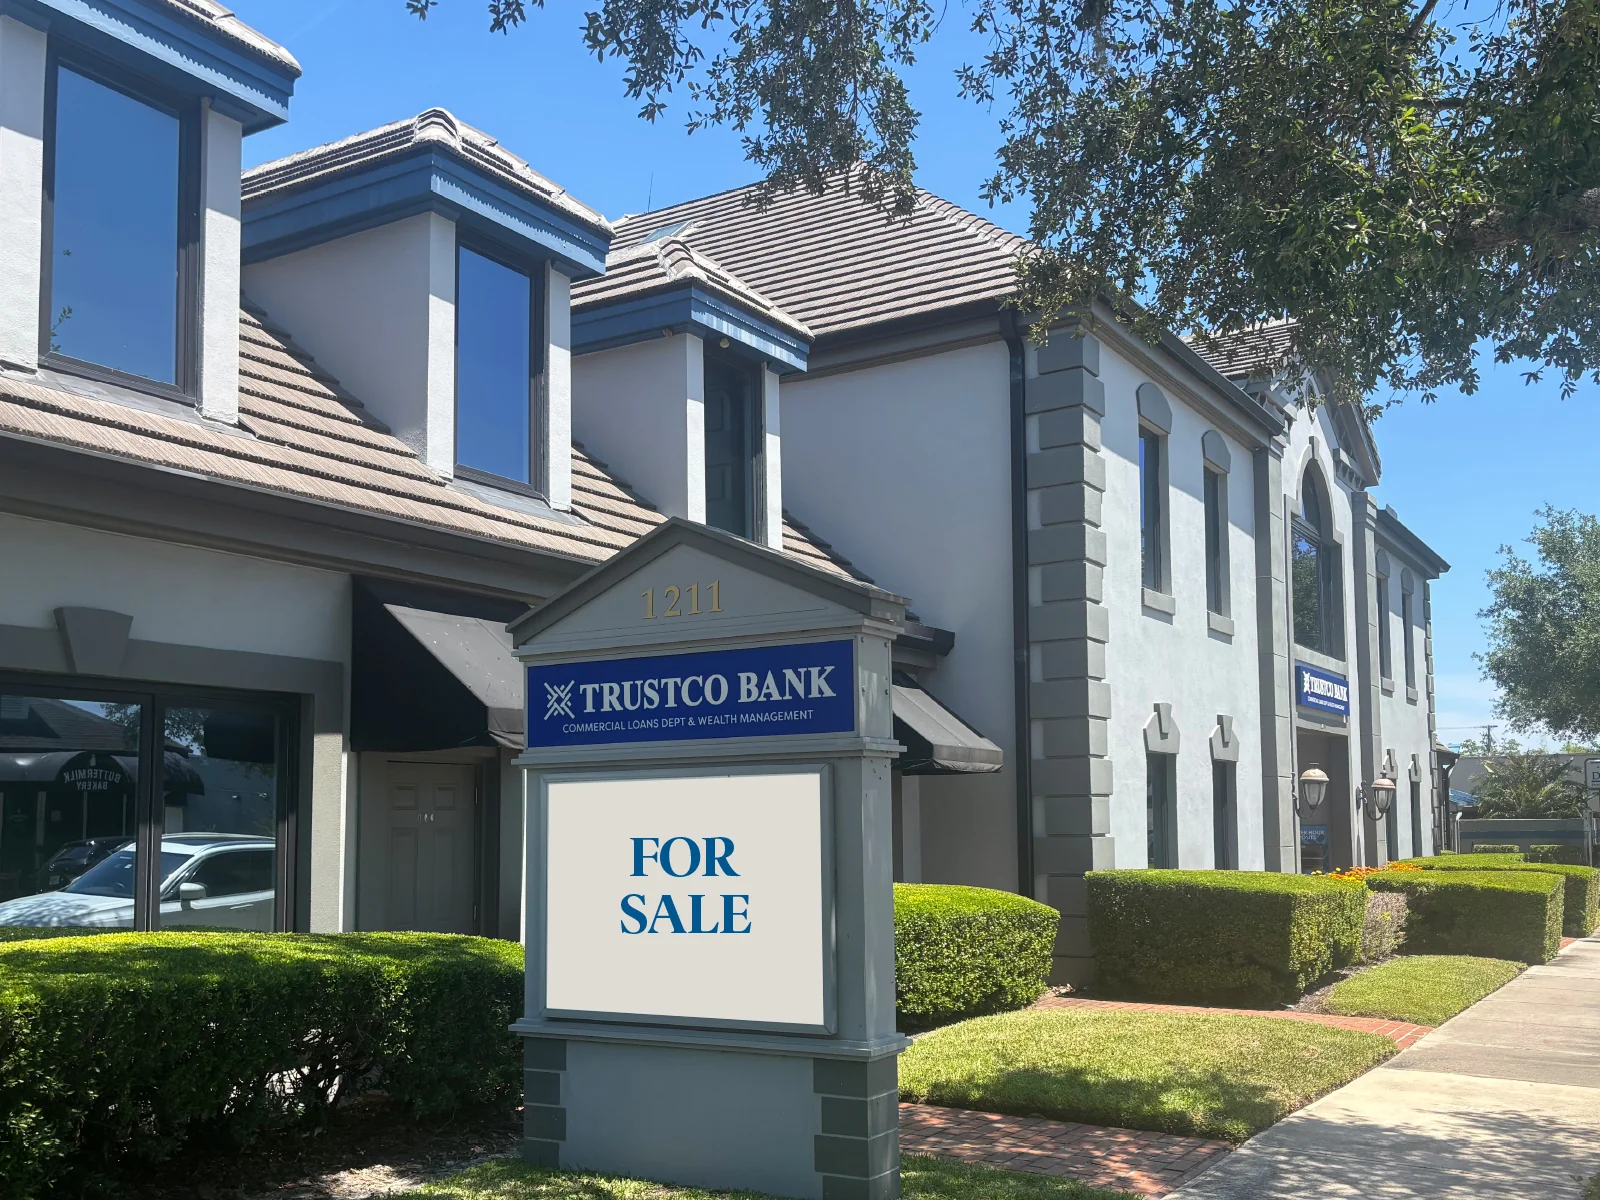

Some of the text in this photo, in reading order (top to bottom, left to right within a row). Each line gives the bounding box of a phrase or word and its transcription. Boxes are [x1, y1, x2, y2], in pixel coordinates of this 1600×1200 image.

[641, 579, 724, 620] 1211
[579, 665, 837, 713] TRUSTCO BANK
[562, 709, 814, 734] COMMERCIAL LOANS DEPT & WEALTH MANAGEMENT
[629, 836, 741, 878] FOR
[620, 893, 752, 935] SALE
